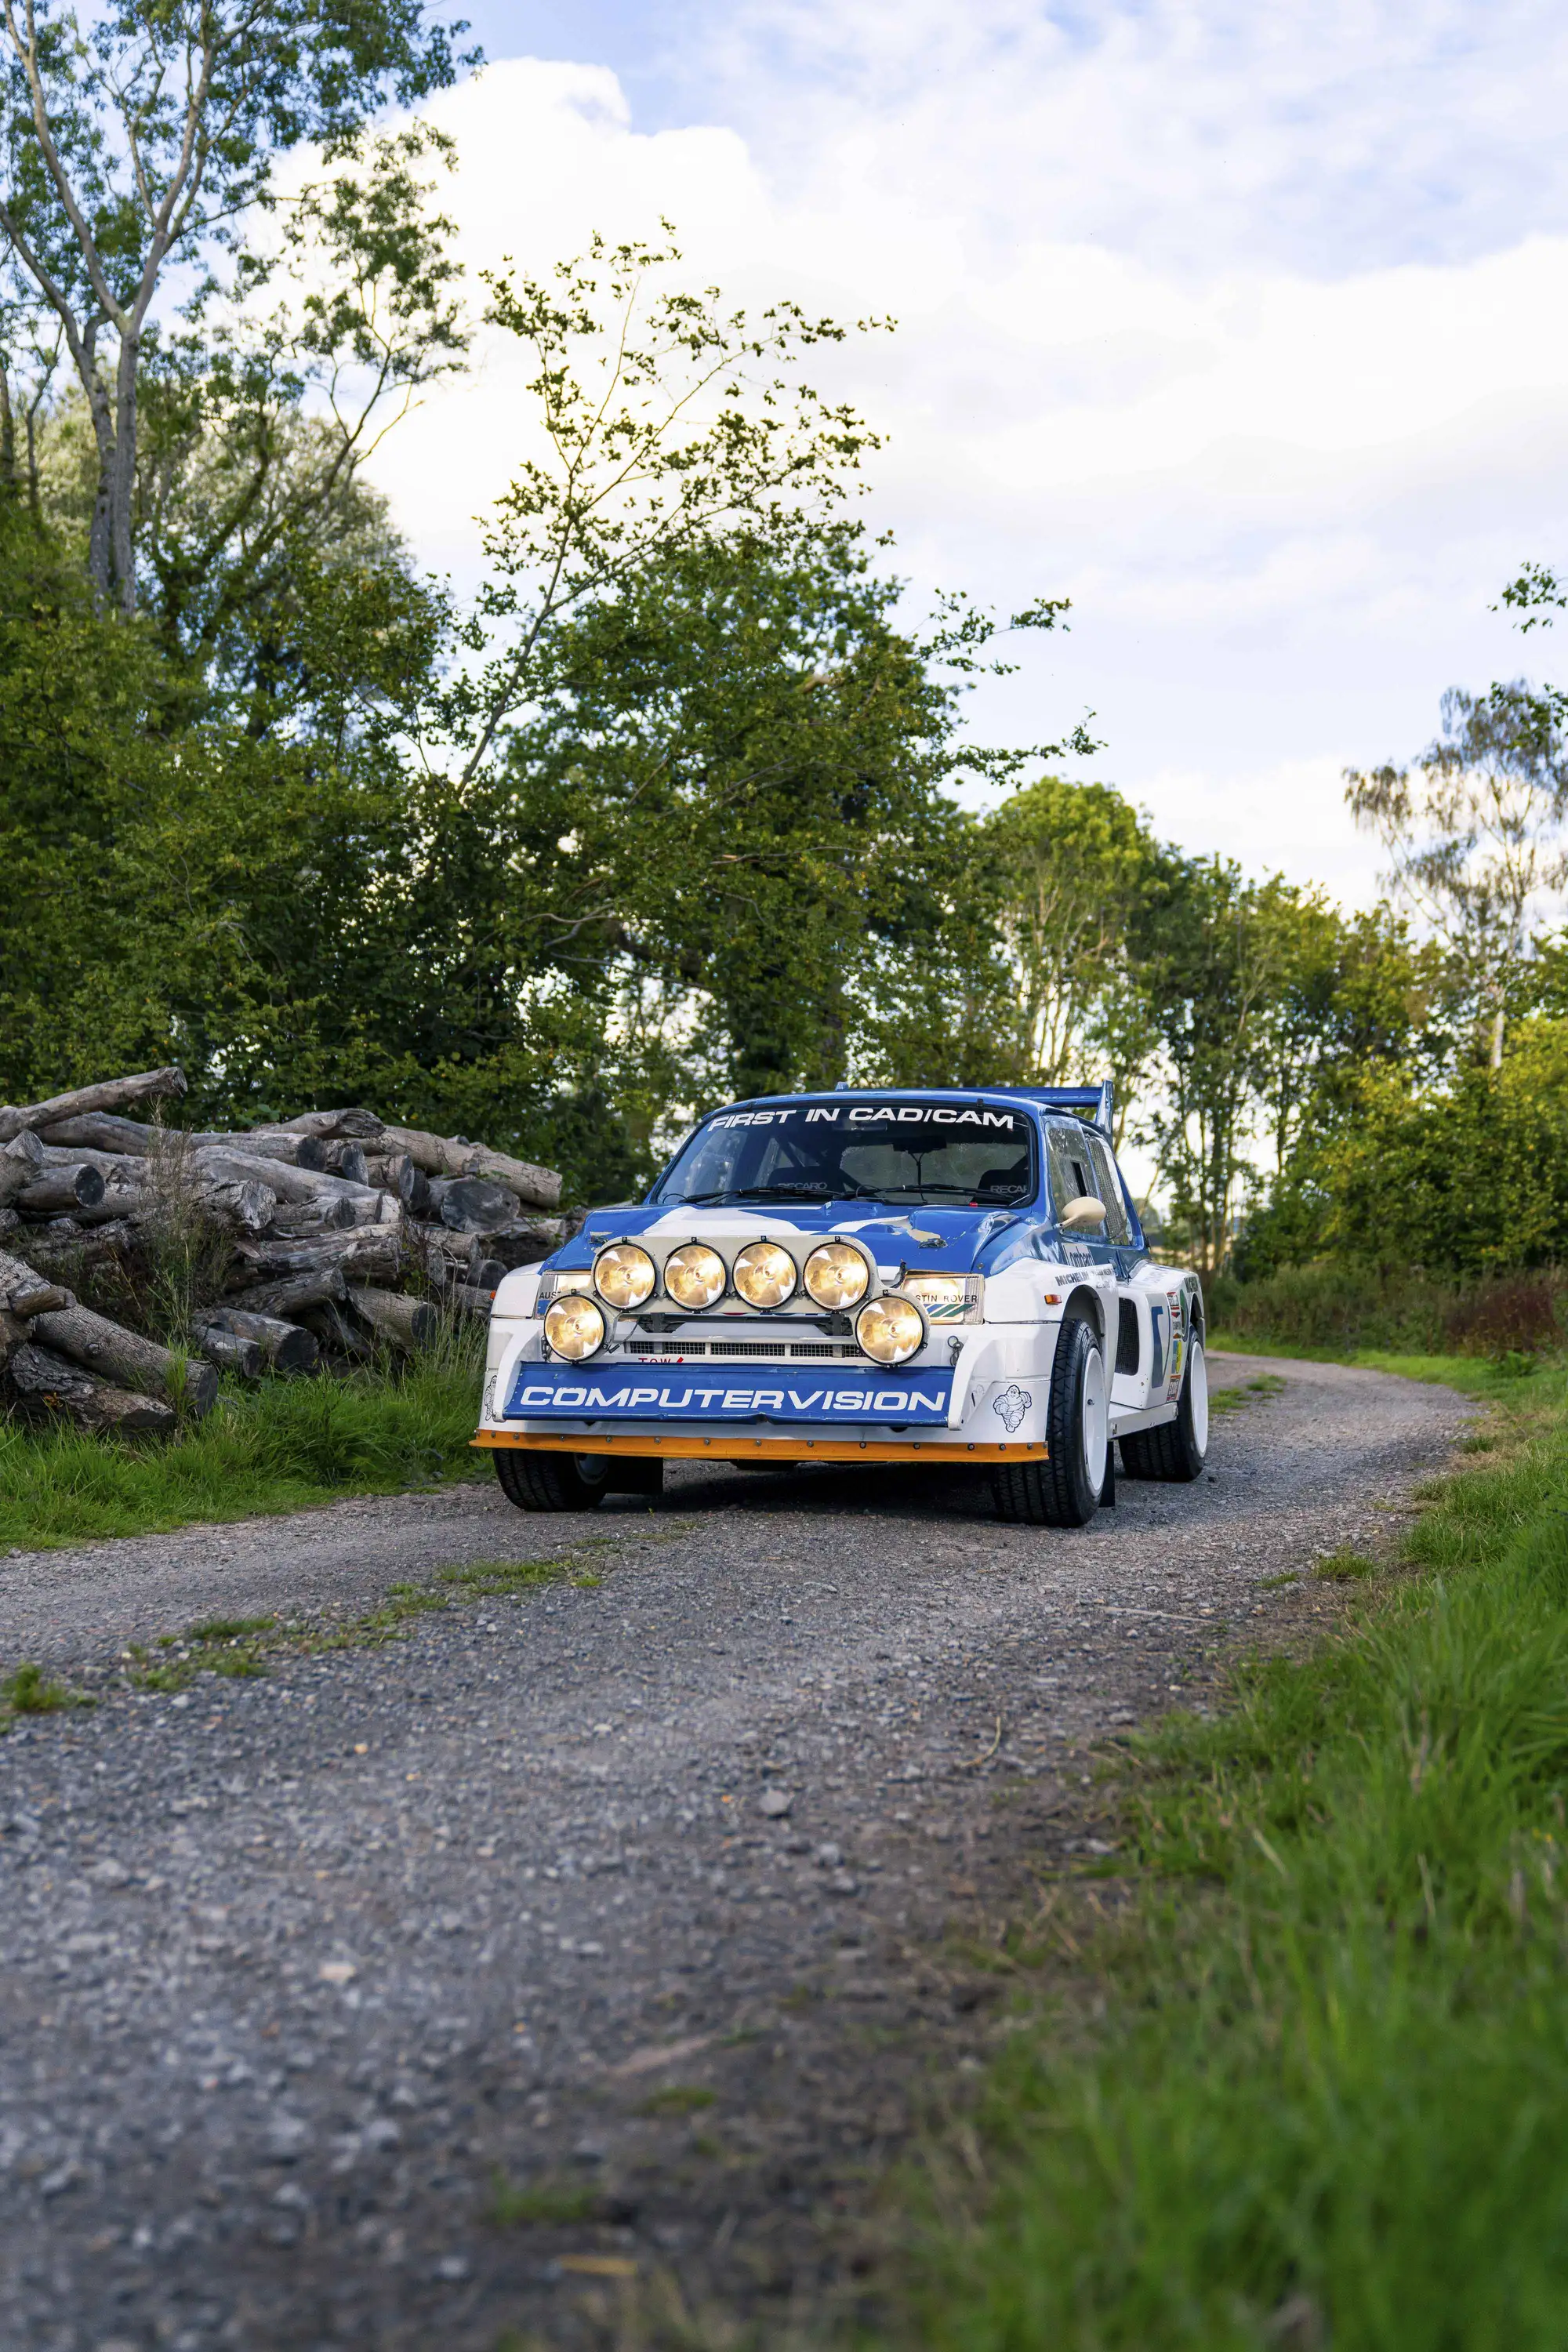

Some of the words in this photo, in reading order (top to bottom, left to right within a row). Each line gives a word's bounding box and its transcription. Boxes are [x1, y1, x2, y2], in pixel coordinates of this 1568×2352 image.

[707, 1110, 797, 1132] FIRST
[805, 1108, 840, 1123] IN
[1054, 1271, 1090, 1287] MICHELIN
[943, 1294, 978, 1303] ROVER
[521, 1386, 946, 1411] COMPUTERVISION
